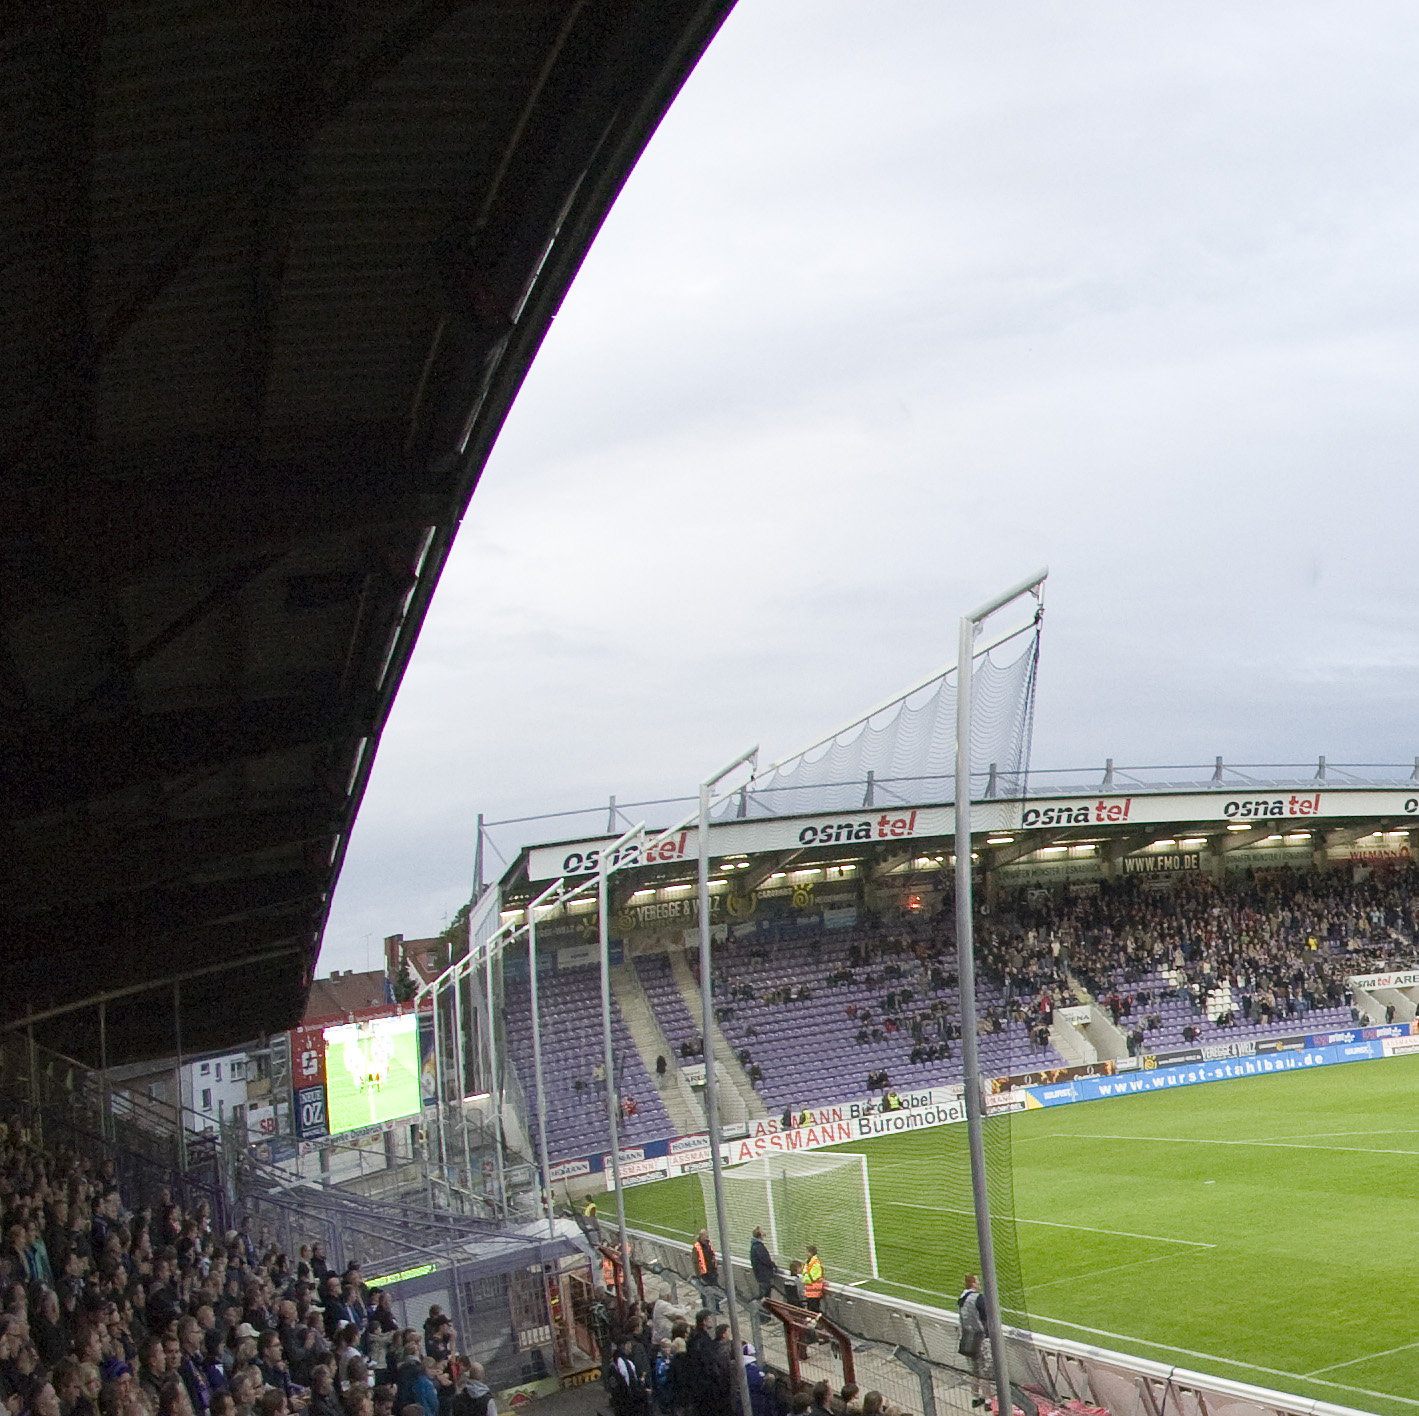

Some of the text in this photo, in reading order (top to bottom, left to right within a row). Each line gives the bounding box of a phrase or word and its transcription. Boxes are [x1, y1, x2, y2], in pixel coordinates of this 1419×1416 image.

[1124, 853, 1198, 875] WWW.FMO.DE
[1099, 1052, 1324, 1097] www.wurst-stahlbau.de
[260, 1118, 275, 1133] SB
[302, 1101, 323, 1127] OZ
[738, 1100, 967, 1161] ASSMANN Büromöbel
